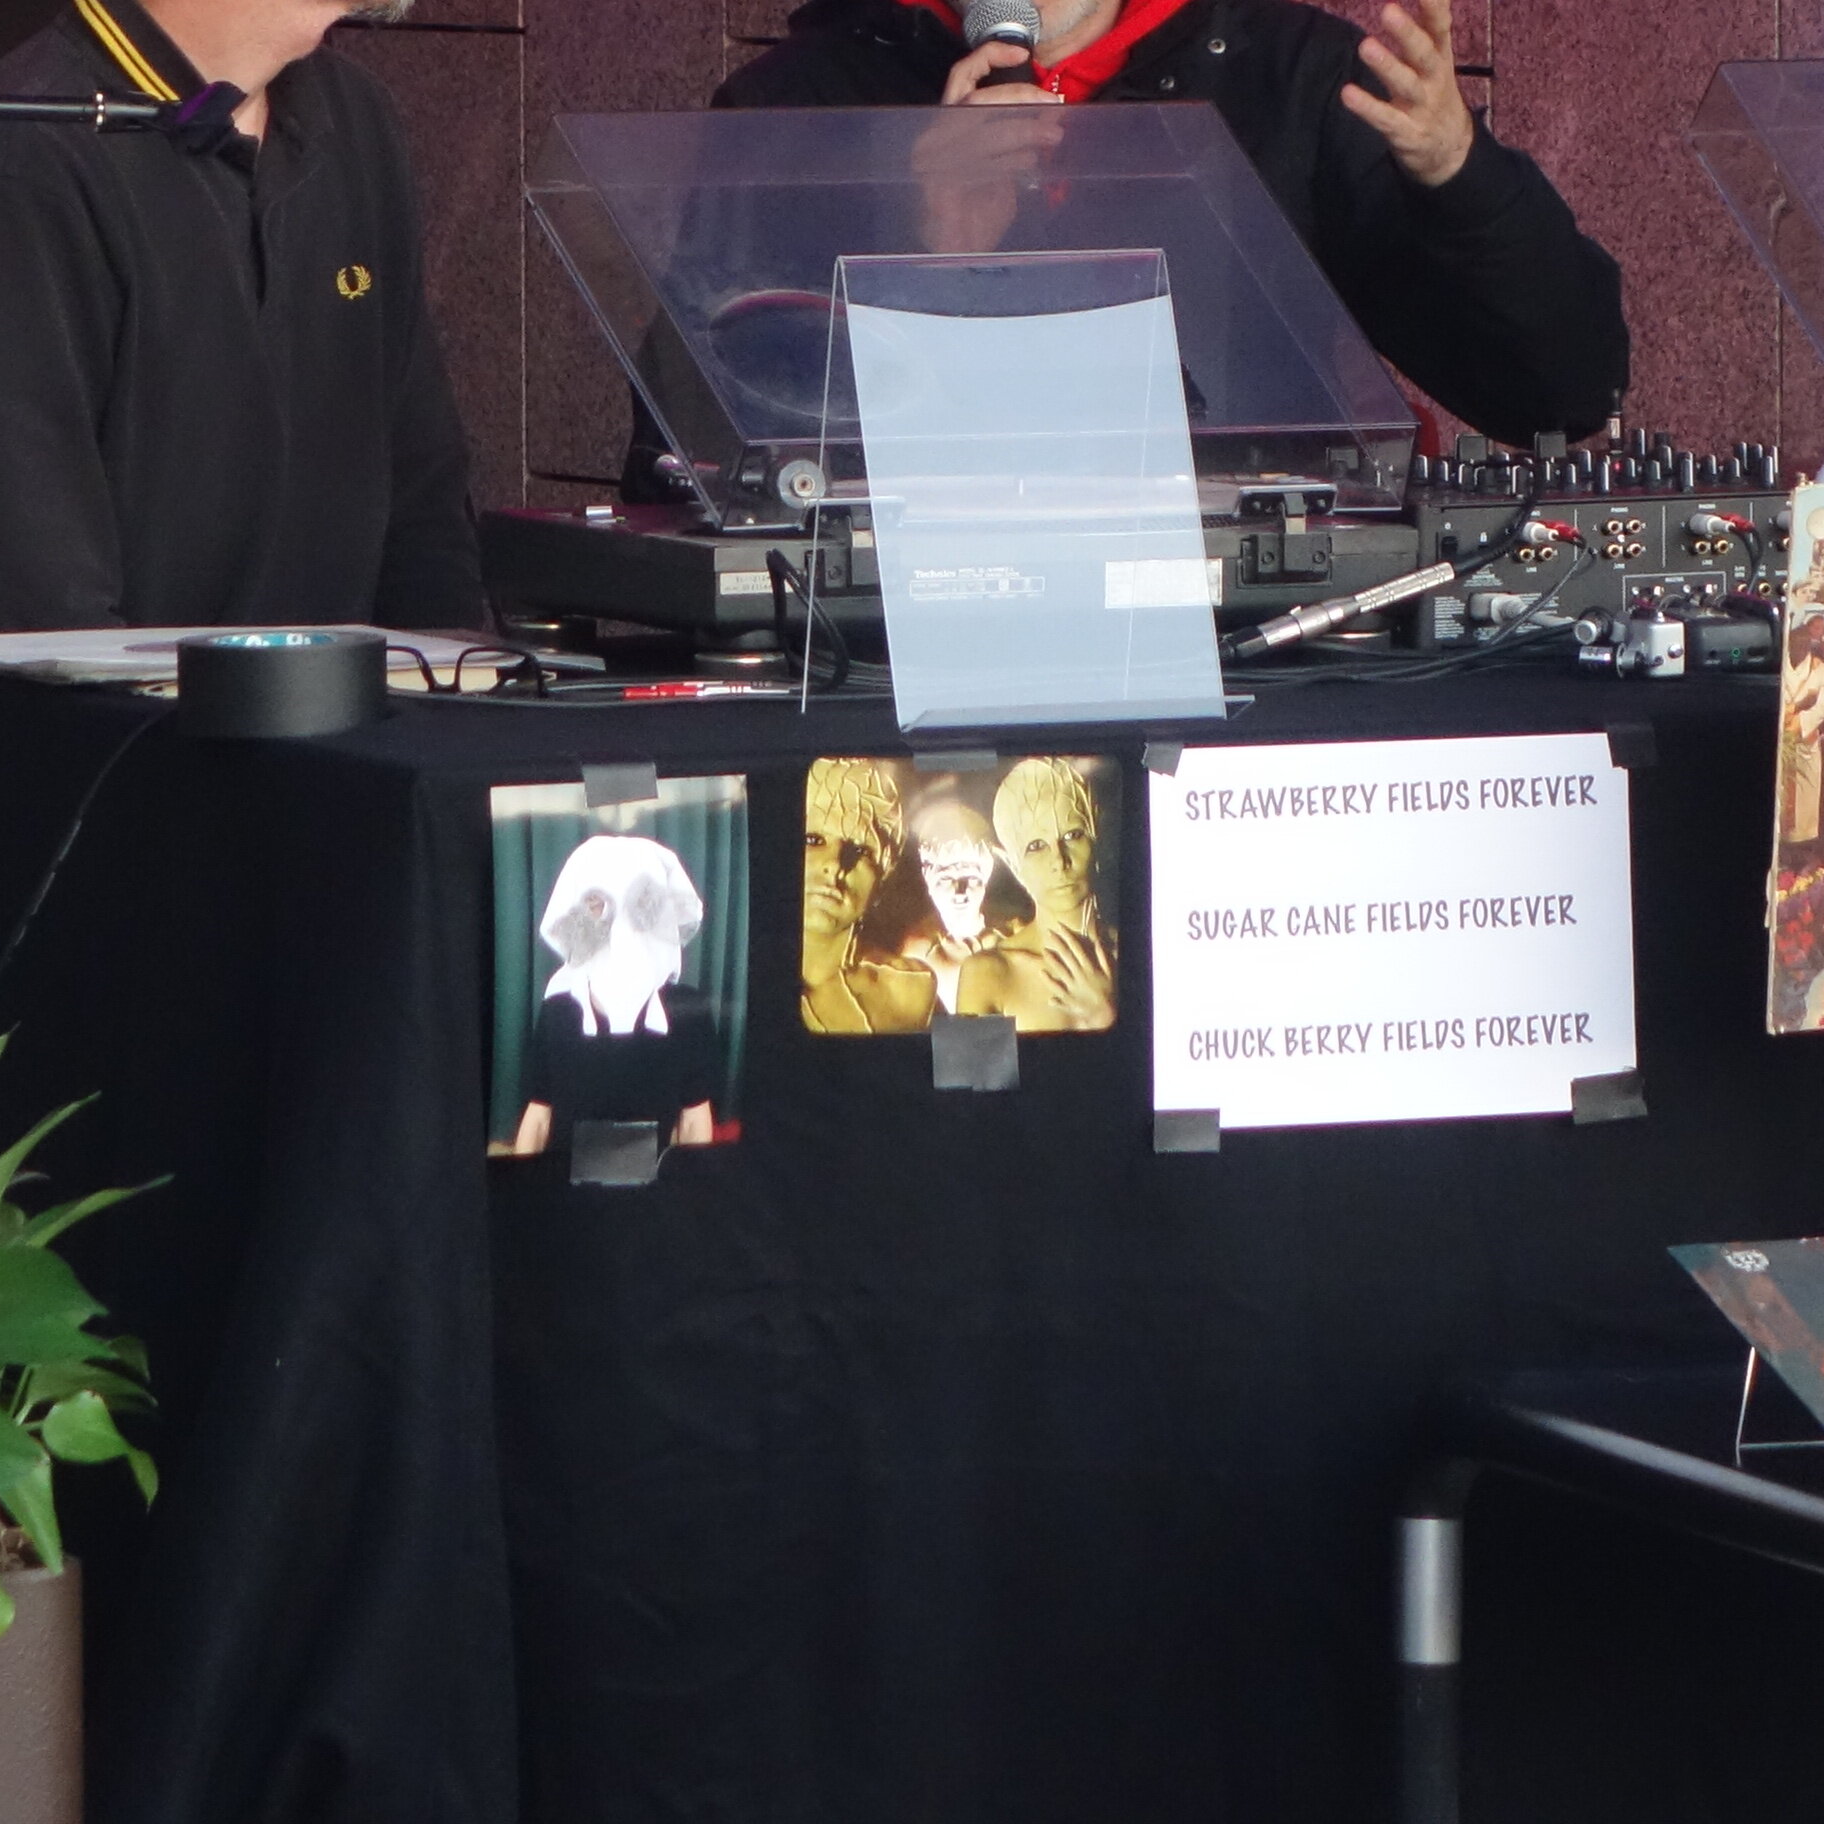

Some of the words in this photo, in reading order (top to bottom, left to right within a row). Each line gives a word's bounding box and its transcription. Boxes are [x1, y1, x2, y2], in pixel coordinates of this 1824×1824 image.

[1185, 783, 1378, 821] STRAWBERRY
[1388, 779, 1470, 813] FIELDS
[1479, 775, 1598, 810] FOREVER
[1187, 907, 1279, 941] SUGAR
[1287, 903, 1358, 936] CANE
[1366, 900, 1450, 933] FIELDS
[1459, 894, 1577, 930] FOREVER
[1189, 1029, 1276, 1061] CHUCK
[1284, 1022, 1374, 1057] BERRY
[1382, 1018, 1466, 1053] FIELDS
[1475, 1012, 1595, 1047] FOREVER
